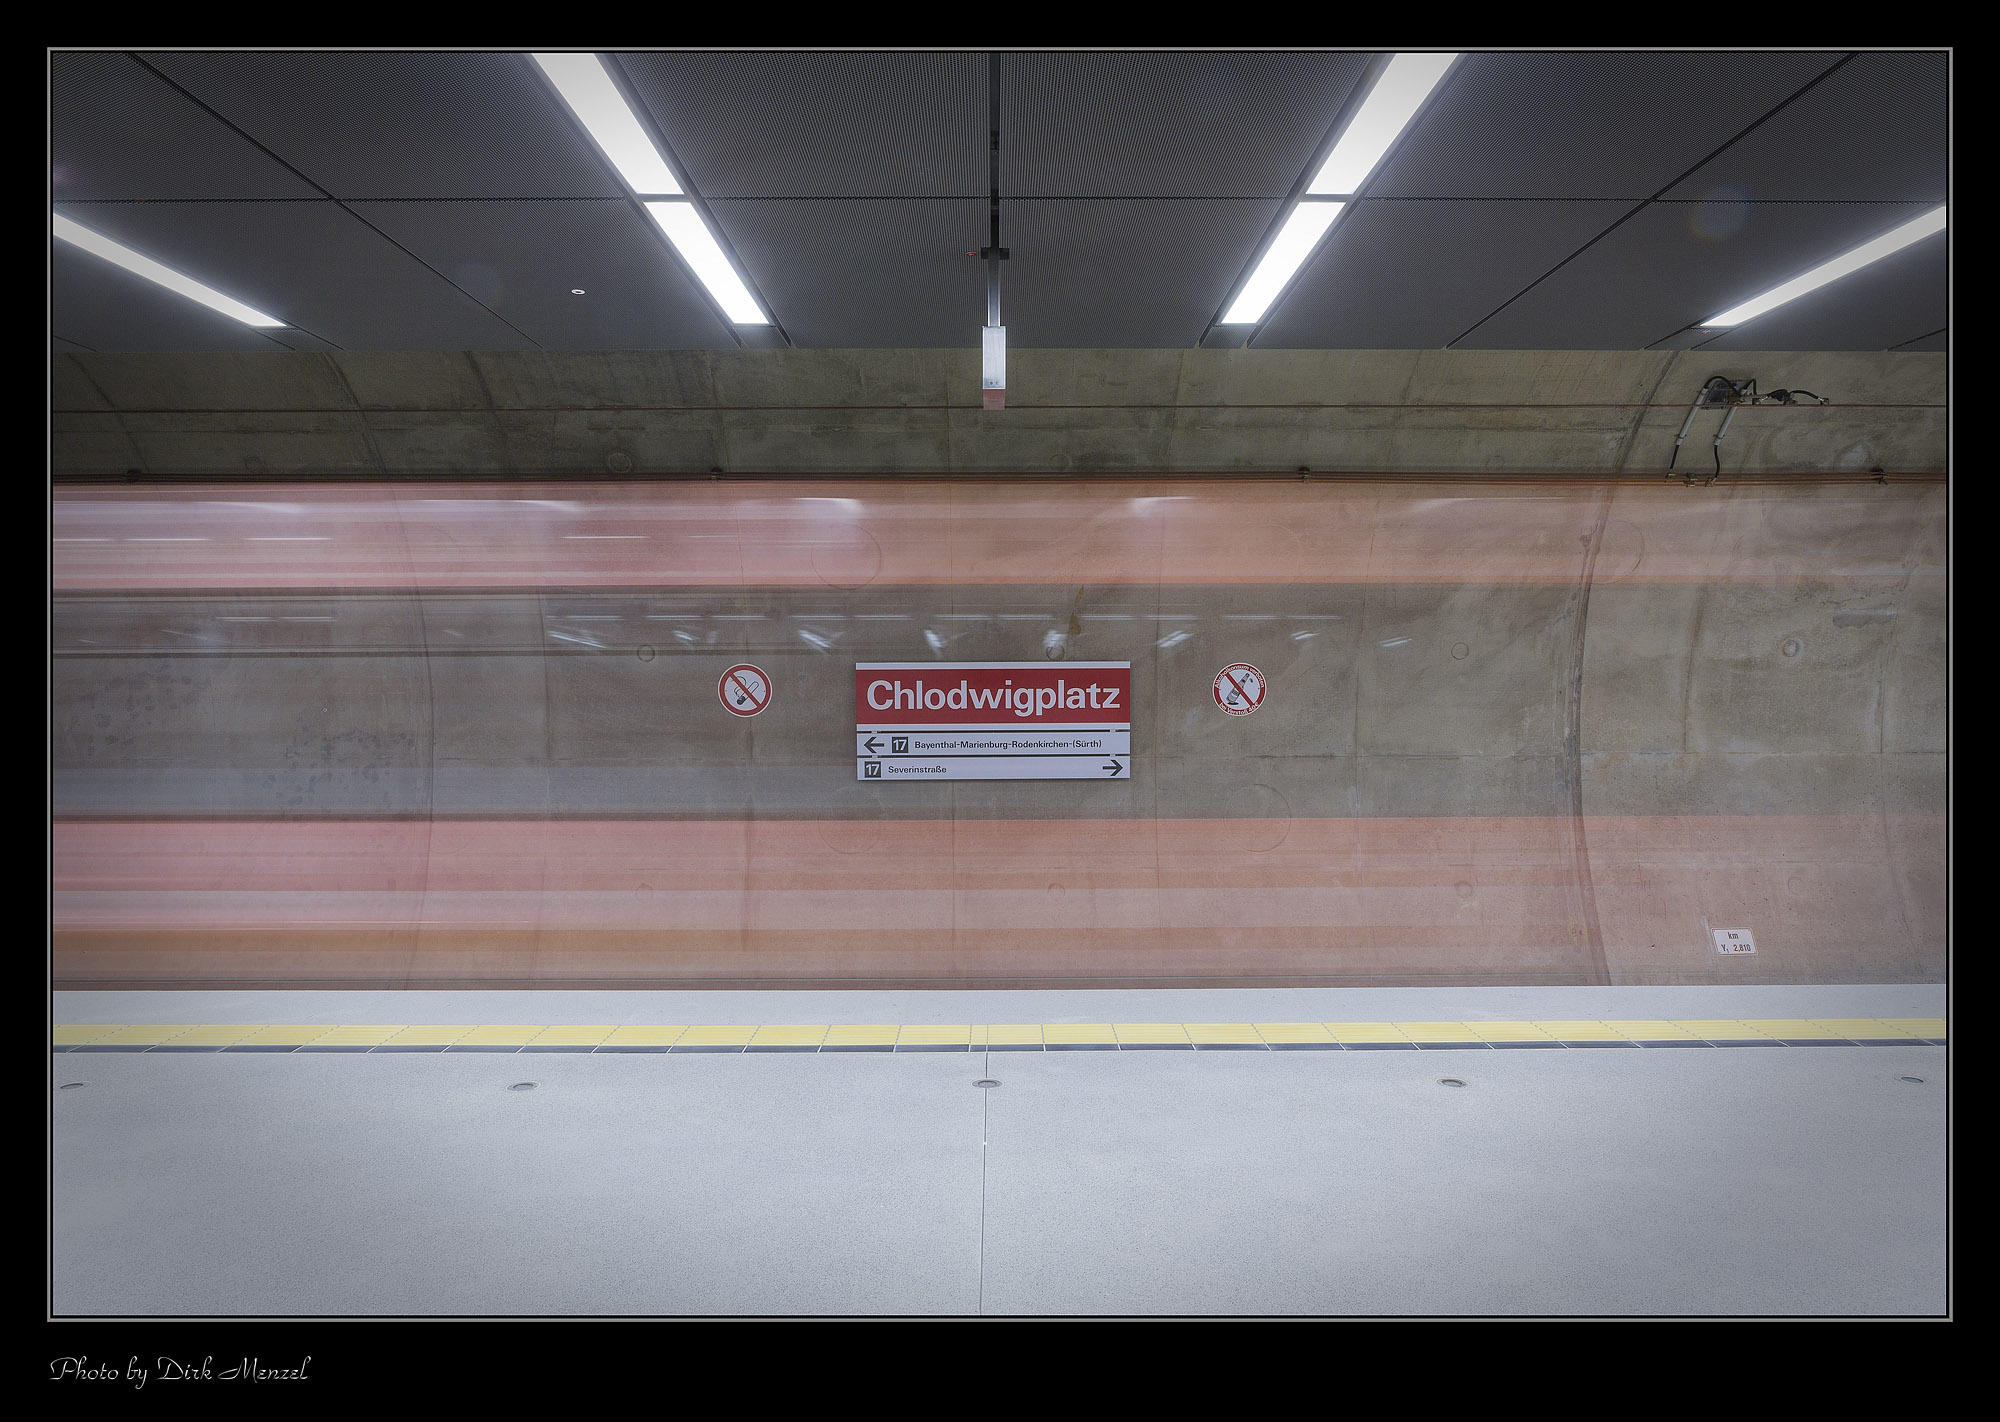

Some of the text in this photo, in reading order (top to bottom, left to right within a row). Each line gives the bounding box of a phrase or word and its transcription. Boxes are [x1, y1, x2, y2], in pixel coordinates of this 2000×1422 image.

[1249, 668, 1264, 688] verboten
[867, 679, 1121, 717] Chlodwigplatz
[893, 739, 1102, 752] 17 Bayenthal-Marienburg-Rodenkirchen-(Sürth)
[865, 763, 947, 777] 17 Severinstraße
[1727, 932, 1739, 940] km
